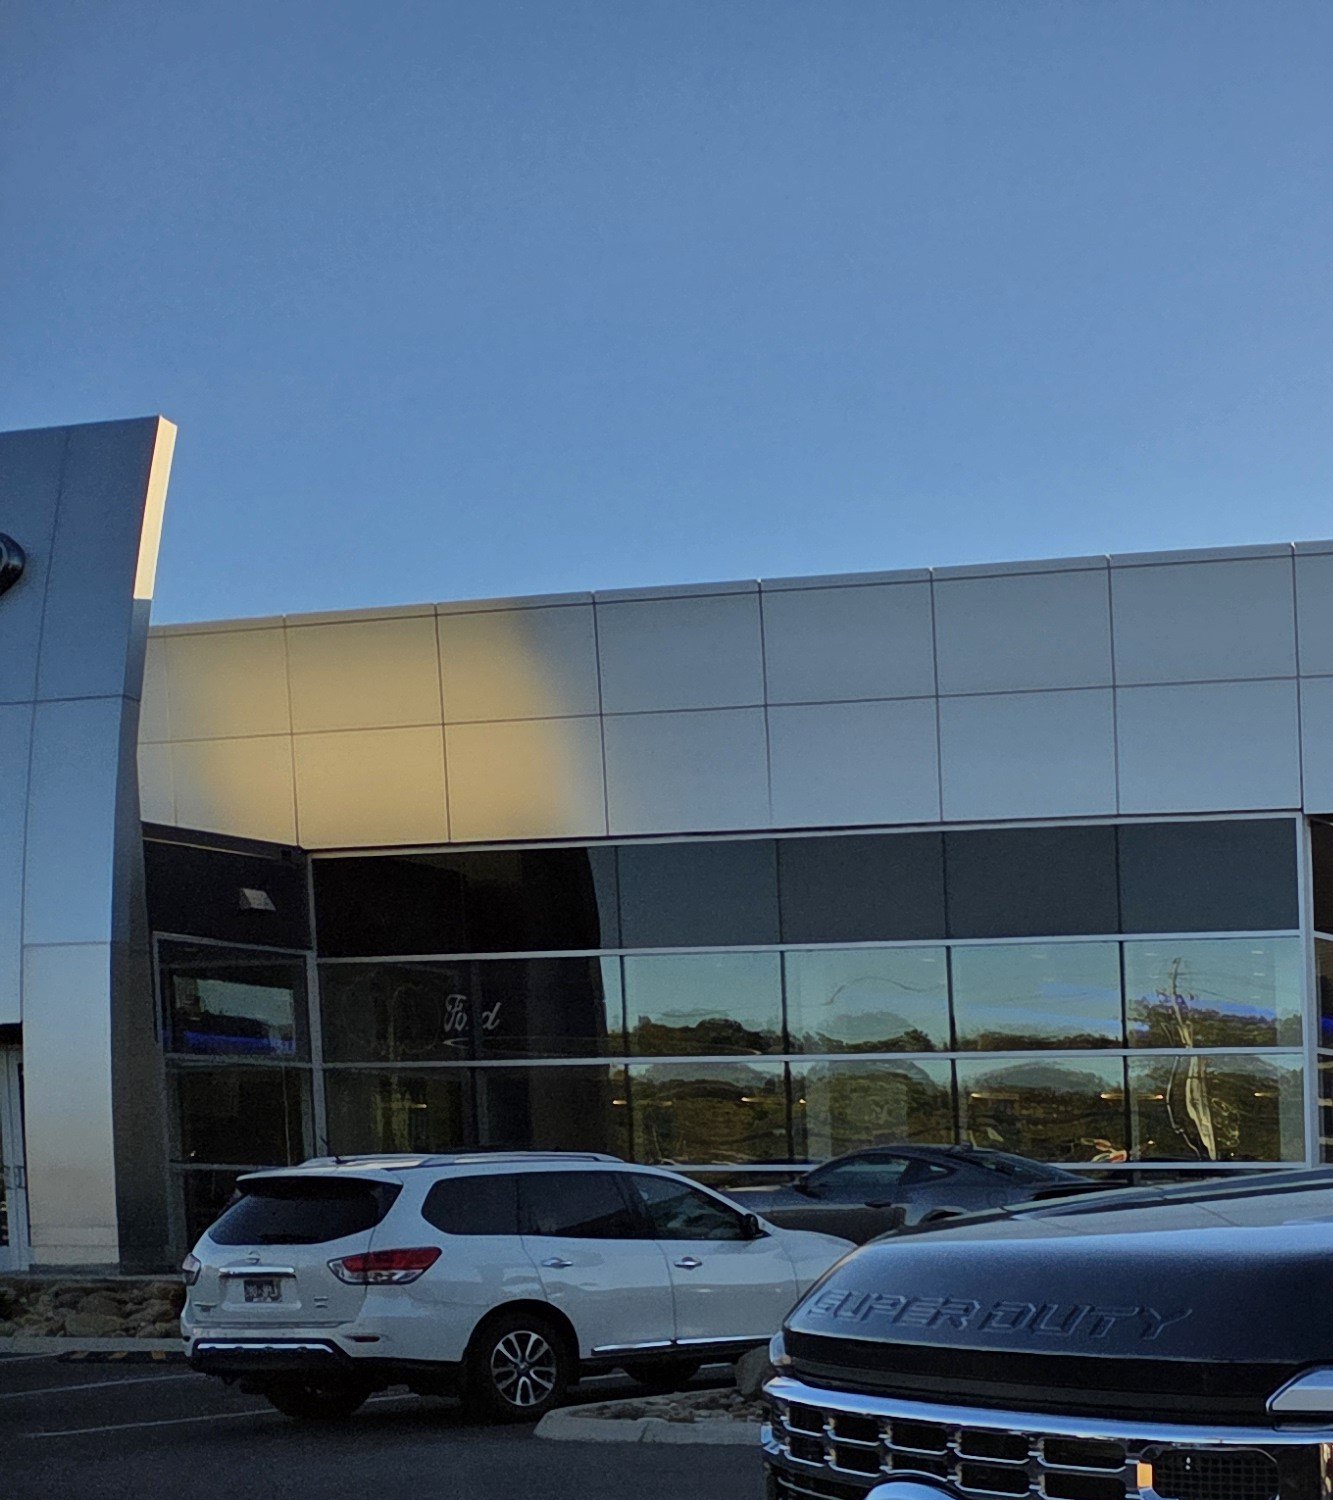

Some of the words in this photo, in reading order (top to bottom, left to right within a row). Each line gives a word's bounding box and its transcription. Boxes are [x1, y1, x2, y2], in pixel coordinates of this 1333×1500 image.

[443, 993, 501, 1034] Fod
[809, 1291, 980, 1331] SUPER
[983, 1298, 1195, 1342] DUTY
